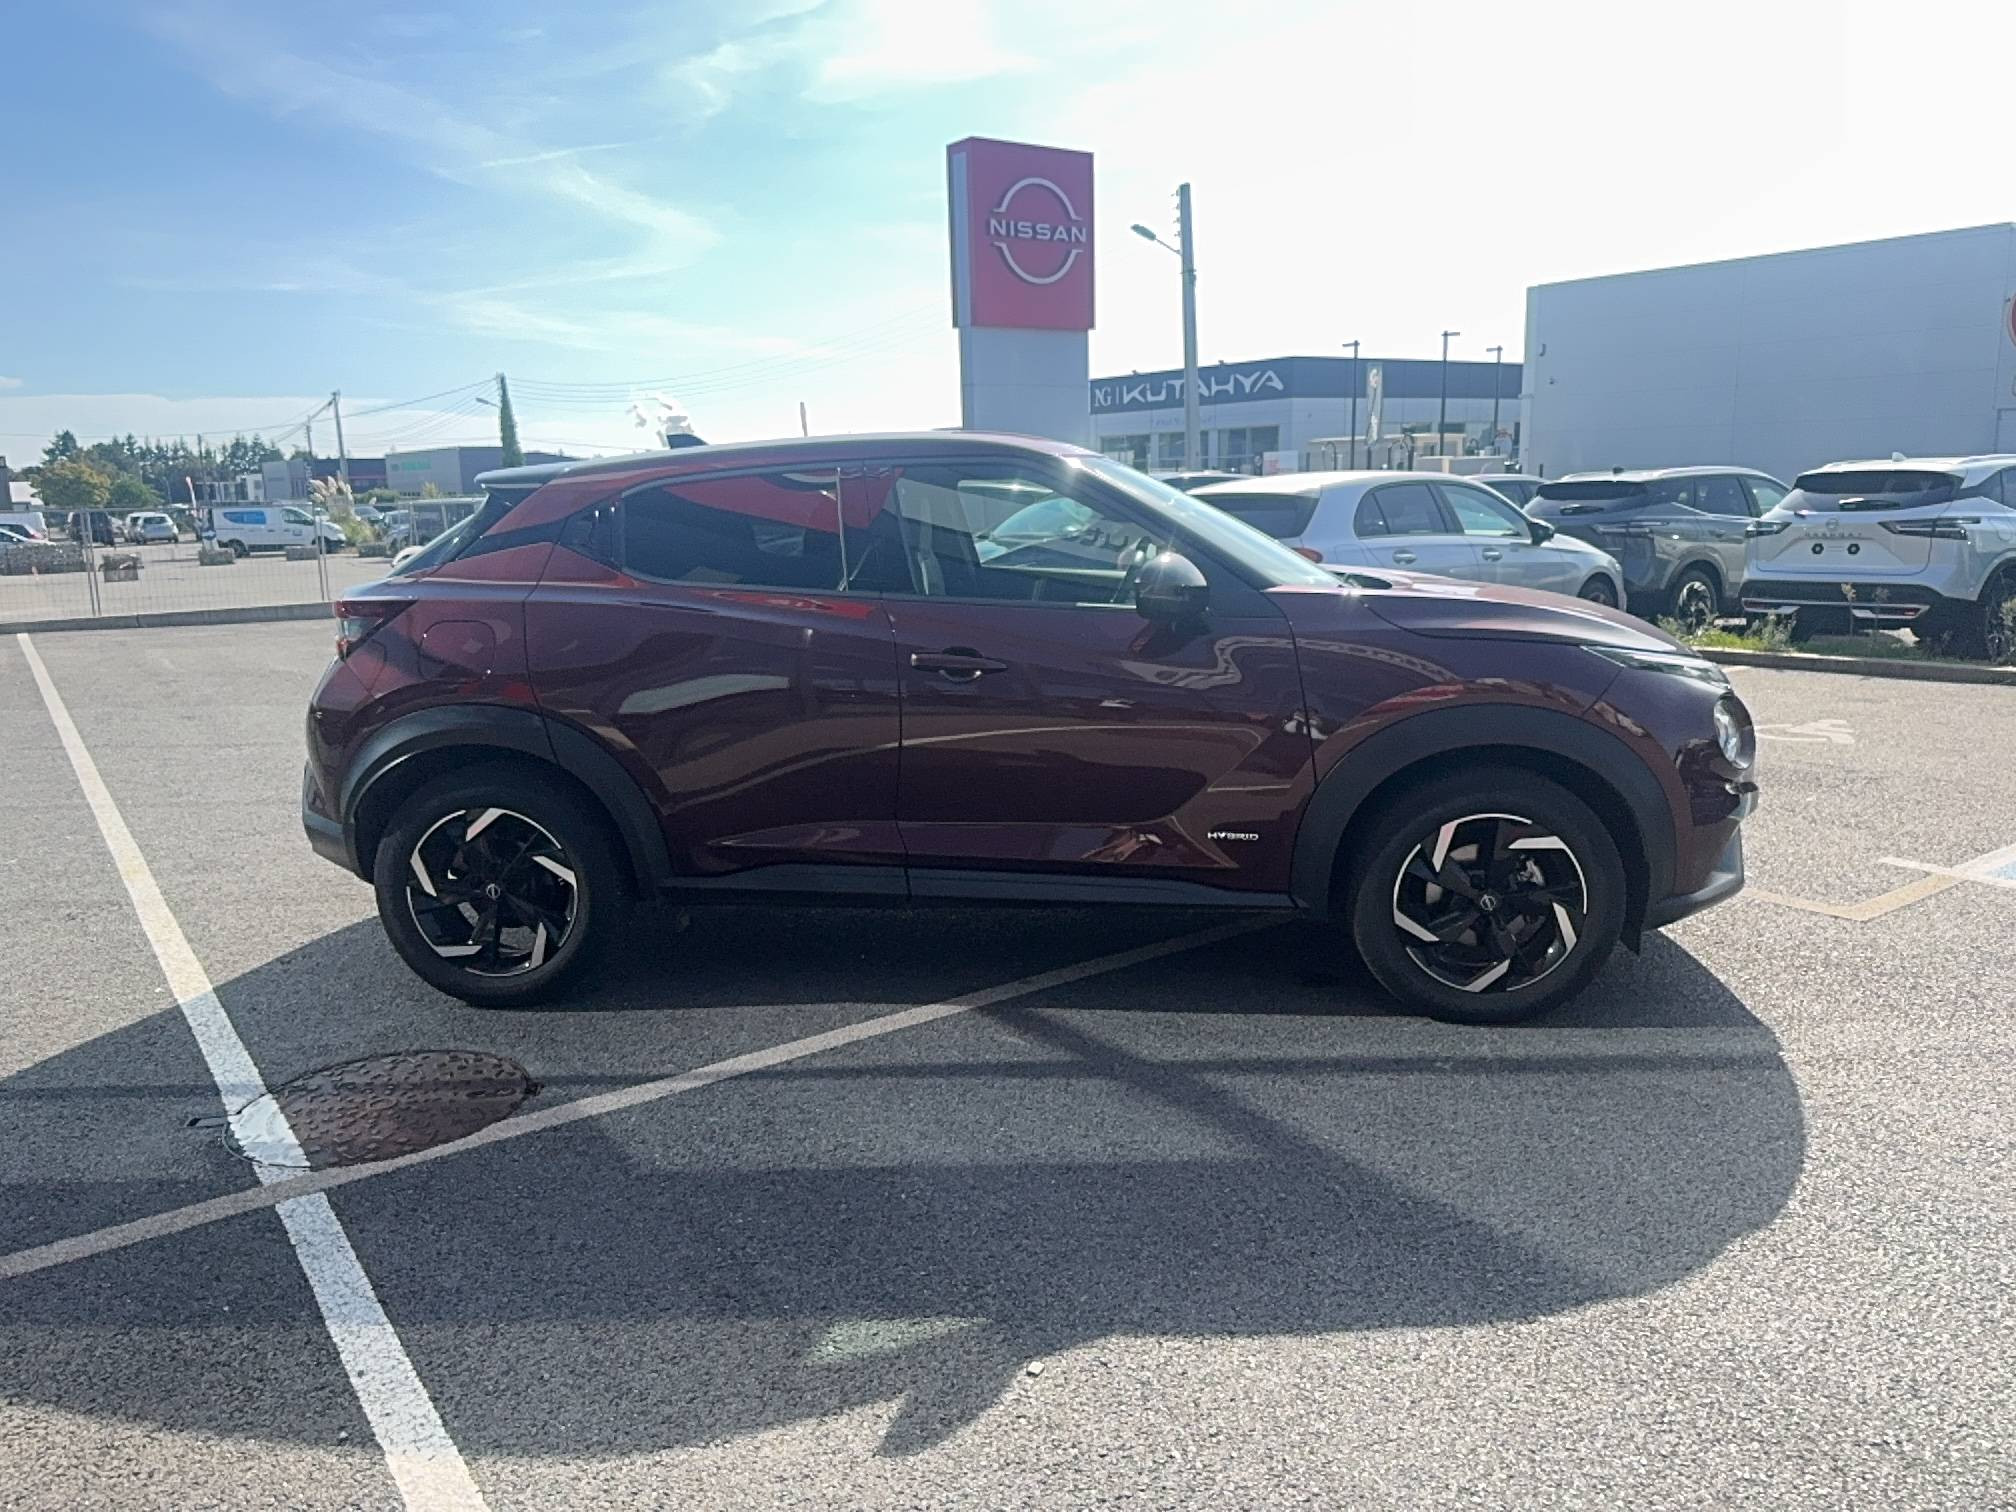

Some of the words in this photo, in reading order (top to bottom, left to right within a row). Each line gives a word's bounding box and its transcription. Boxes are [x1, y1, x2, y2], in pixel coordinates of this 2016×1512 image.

[989, 218, 1087, 242] NISSAN
[1094, 386, 1112, 407] NG
[1208, 832, 1259, 840] HYBRID
